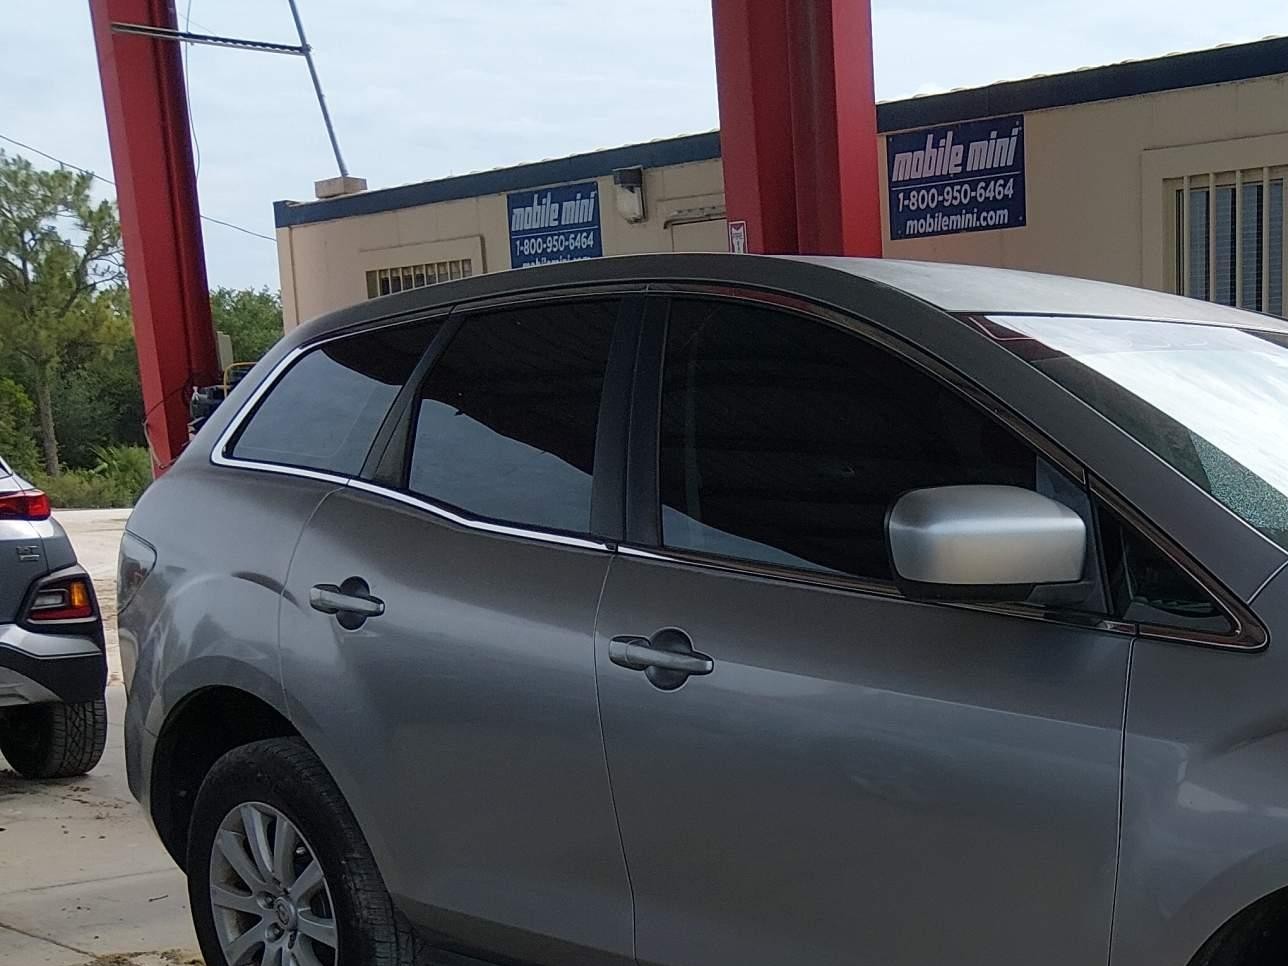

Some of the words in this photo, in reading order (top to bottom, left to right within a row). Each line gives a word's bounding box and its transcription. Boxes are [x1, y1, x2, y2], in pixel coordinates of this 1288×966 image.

[892, 131, 964, 182] mobile
[966, 127, 1019, 172] mini
[511, 191, 559, 231] mobile
[561, 191, 595, 225] mini
[898, 178, 1014, 212] 1-800-950-6464
[905, 208, 1009, 235] mobilemini.com
[516, 231, 594, 256] 1-800-950-6464
